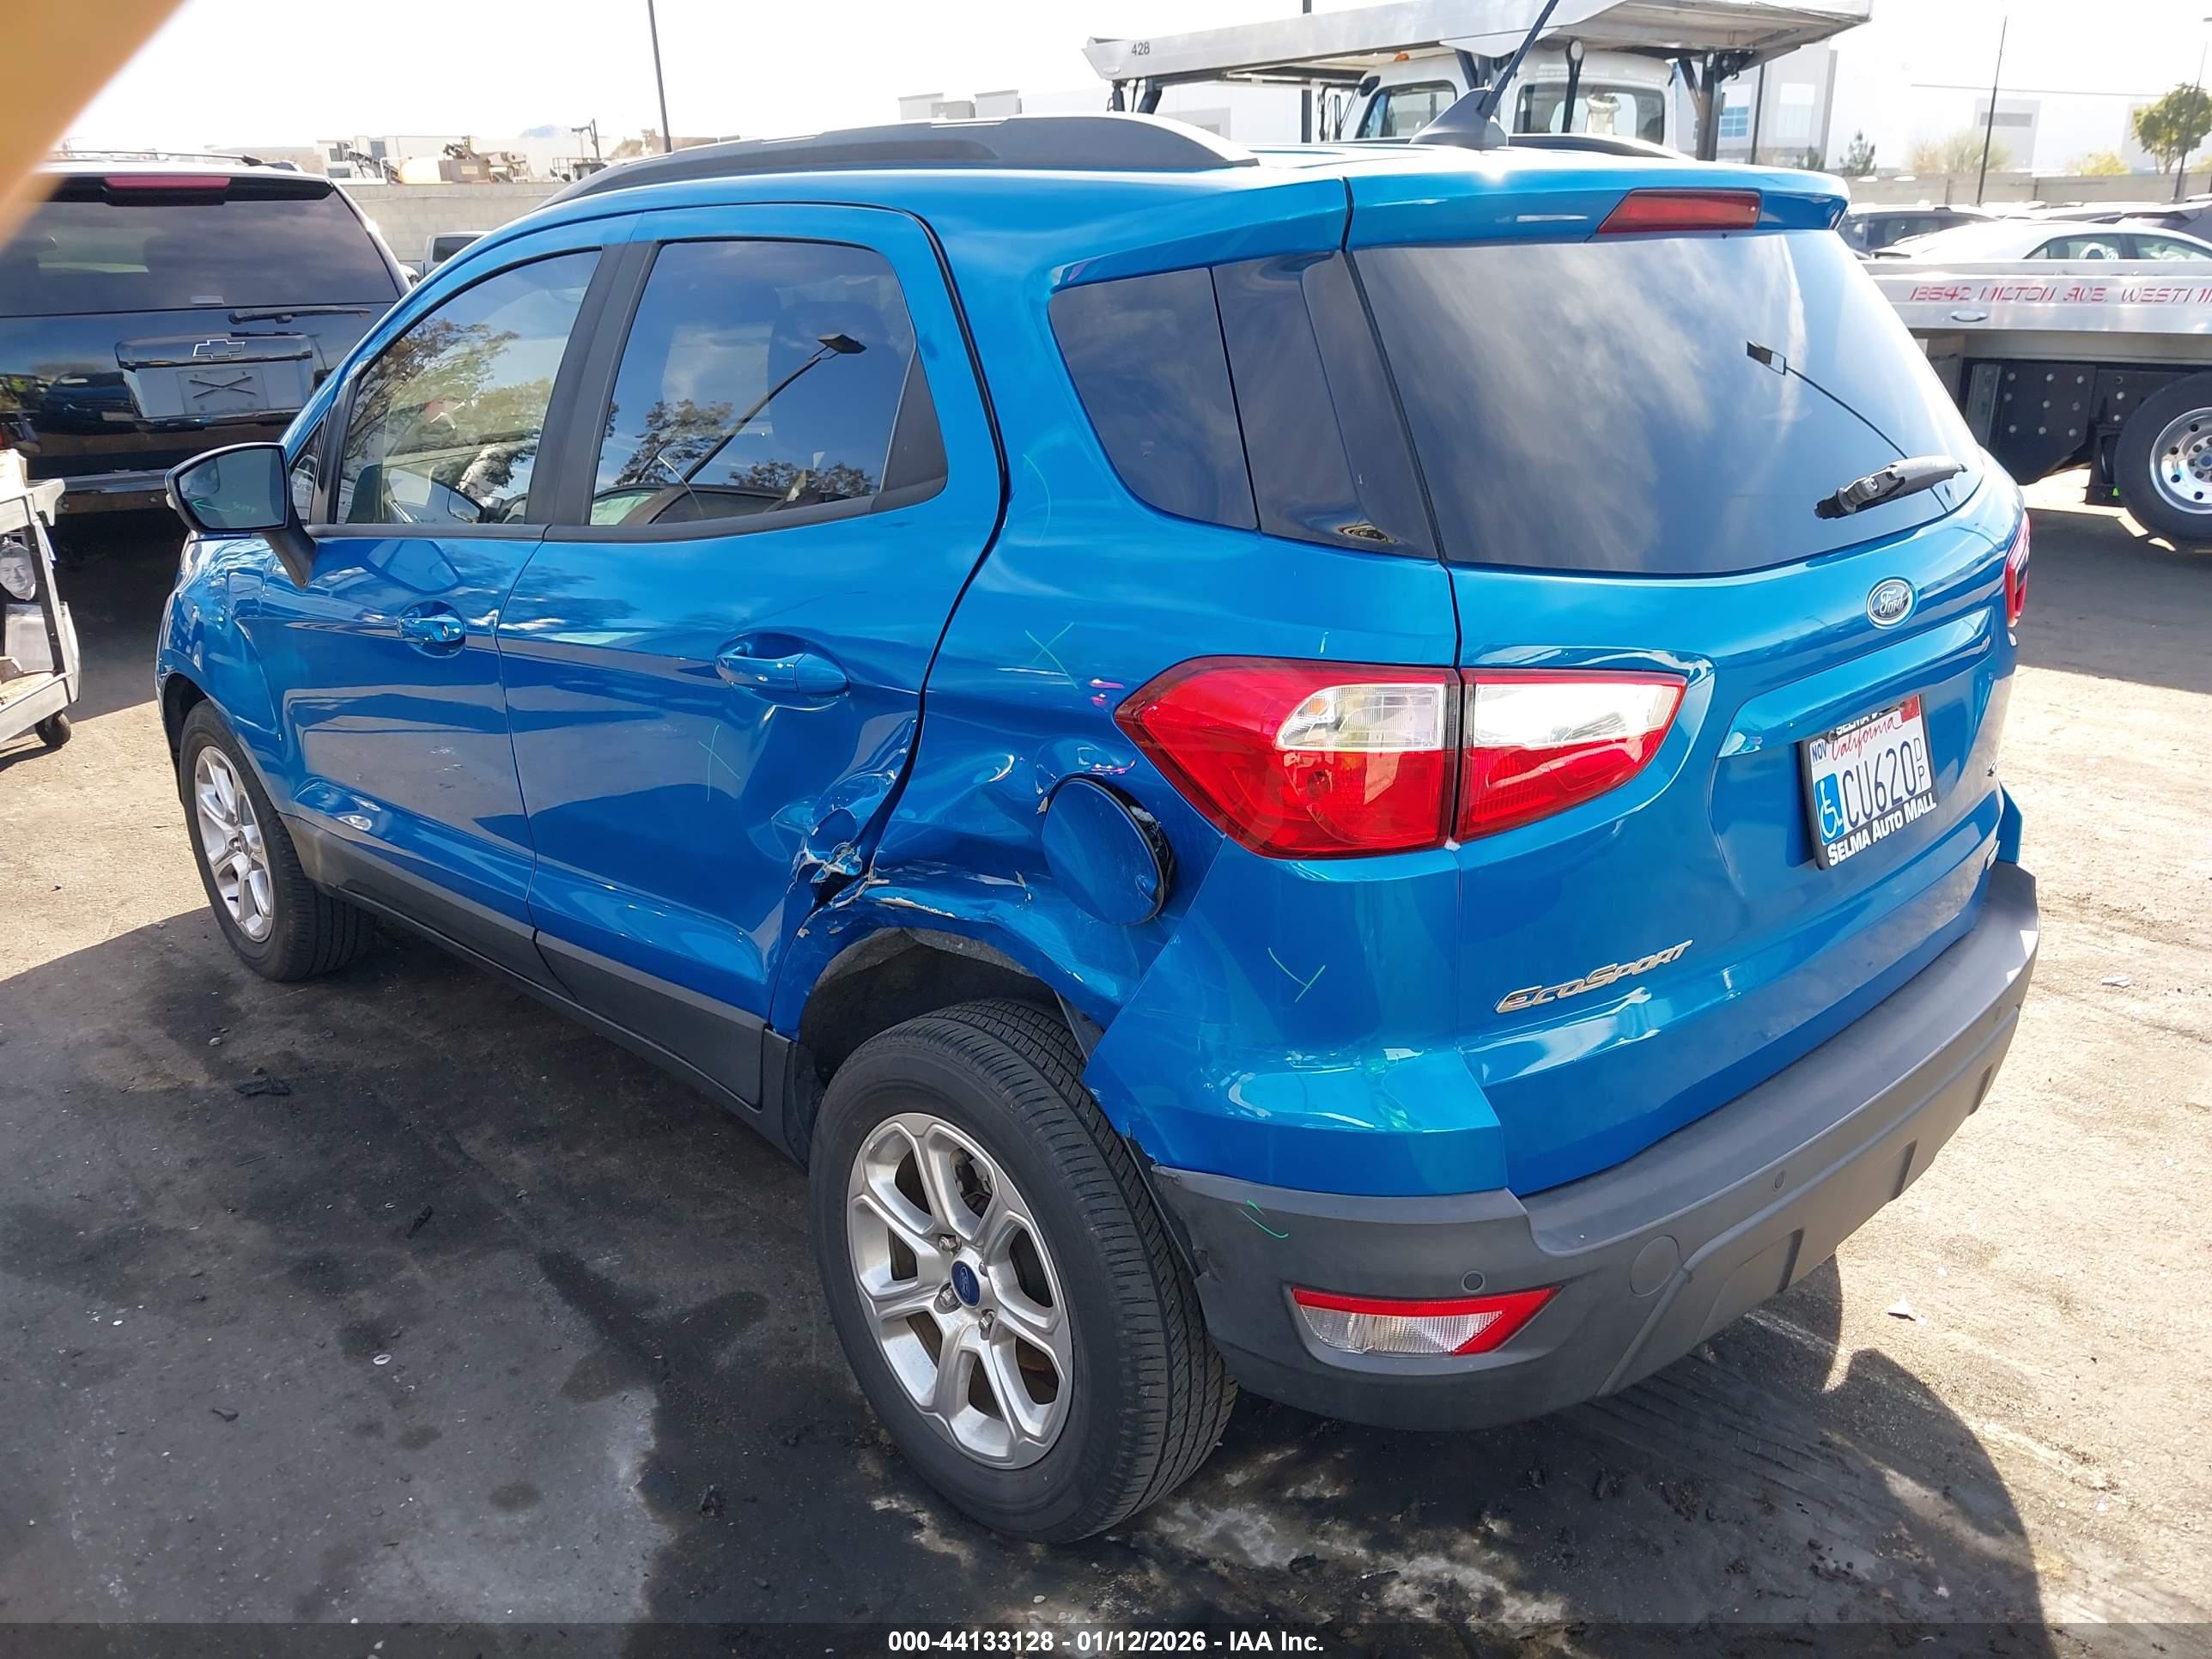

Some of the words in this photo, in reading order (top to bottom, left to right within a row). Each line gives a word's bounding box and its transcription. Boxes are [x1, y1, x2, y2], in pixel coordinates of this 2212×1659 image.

[1131, 41, 1151, 56] 428
[1879, 588, 1909, 617] Ford
[1811, 741, 1827, 763] NOV
[1831, 716, 1903, 762] California
[1827, 829, 1870, 866] SELMA
[1872, 810, 1904, 843] AUTO
[1904, 792, 1937, 825] MALL
